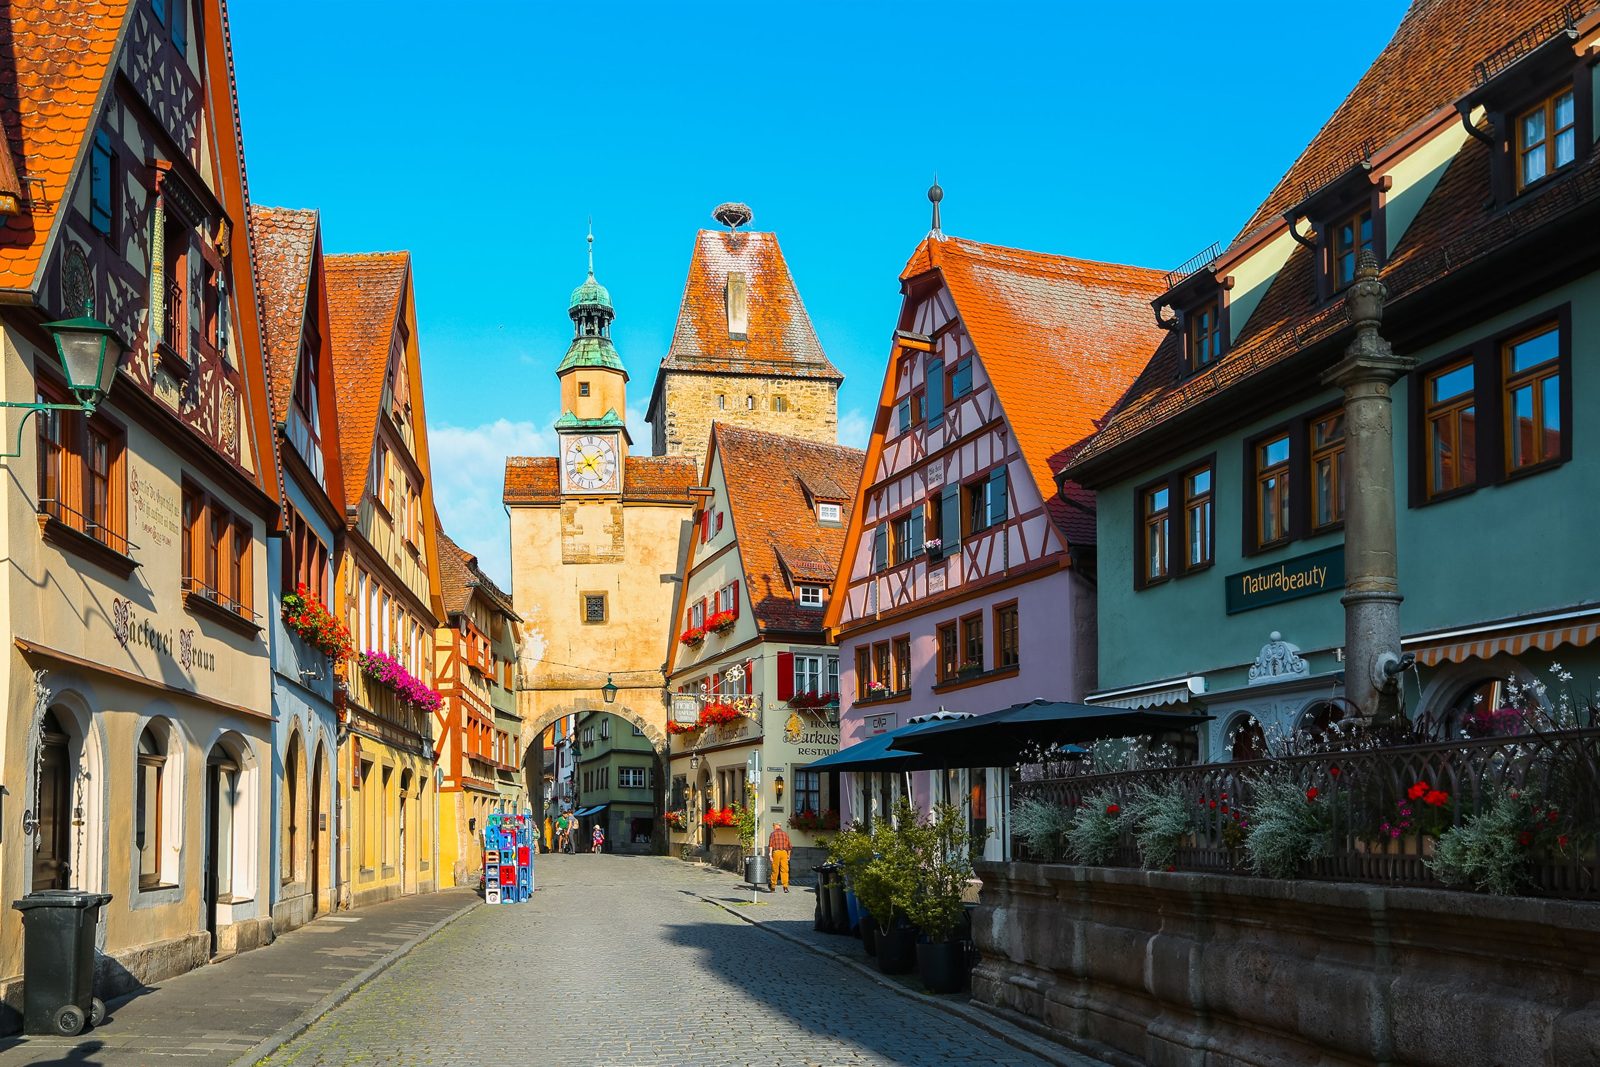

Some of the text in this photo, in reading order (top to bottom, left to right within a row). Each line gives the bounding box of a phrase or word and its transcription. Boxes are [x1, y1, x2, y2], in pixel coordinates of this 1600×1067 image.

[1243, 565, 1327, 595] naturabeauty
[113, 597, 216, 673] Bäckerei Braun
[788, 730, 840, 745] arkus
